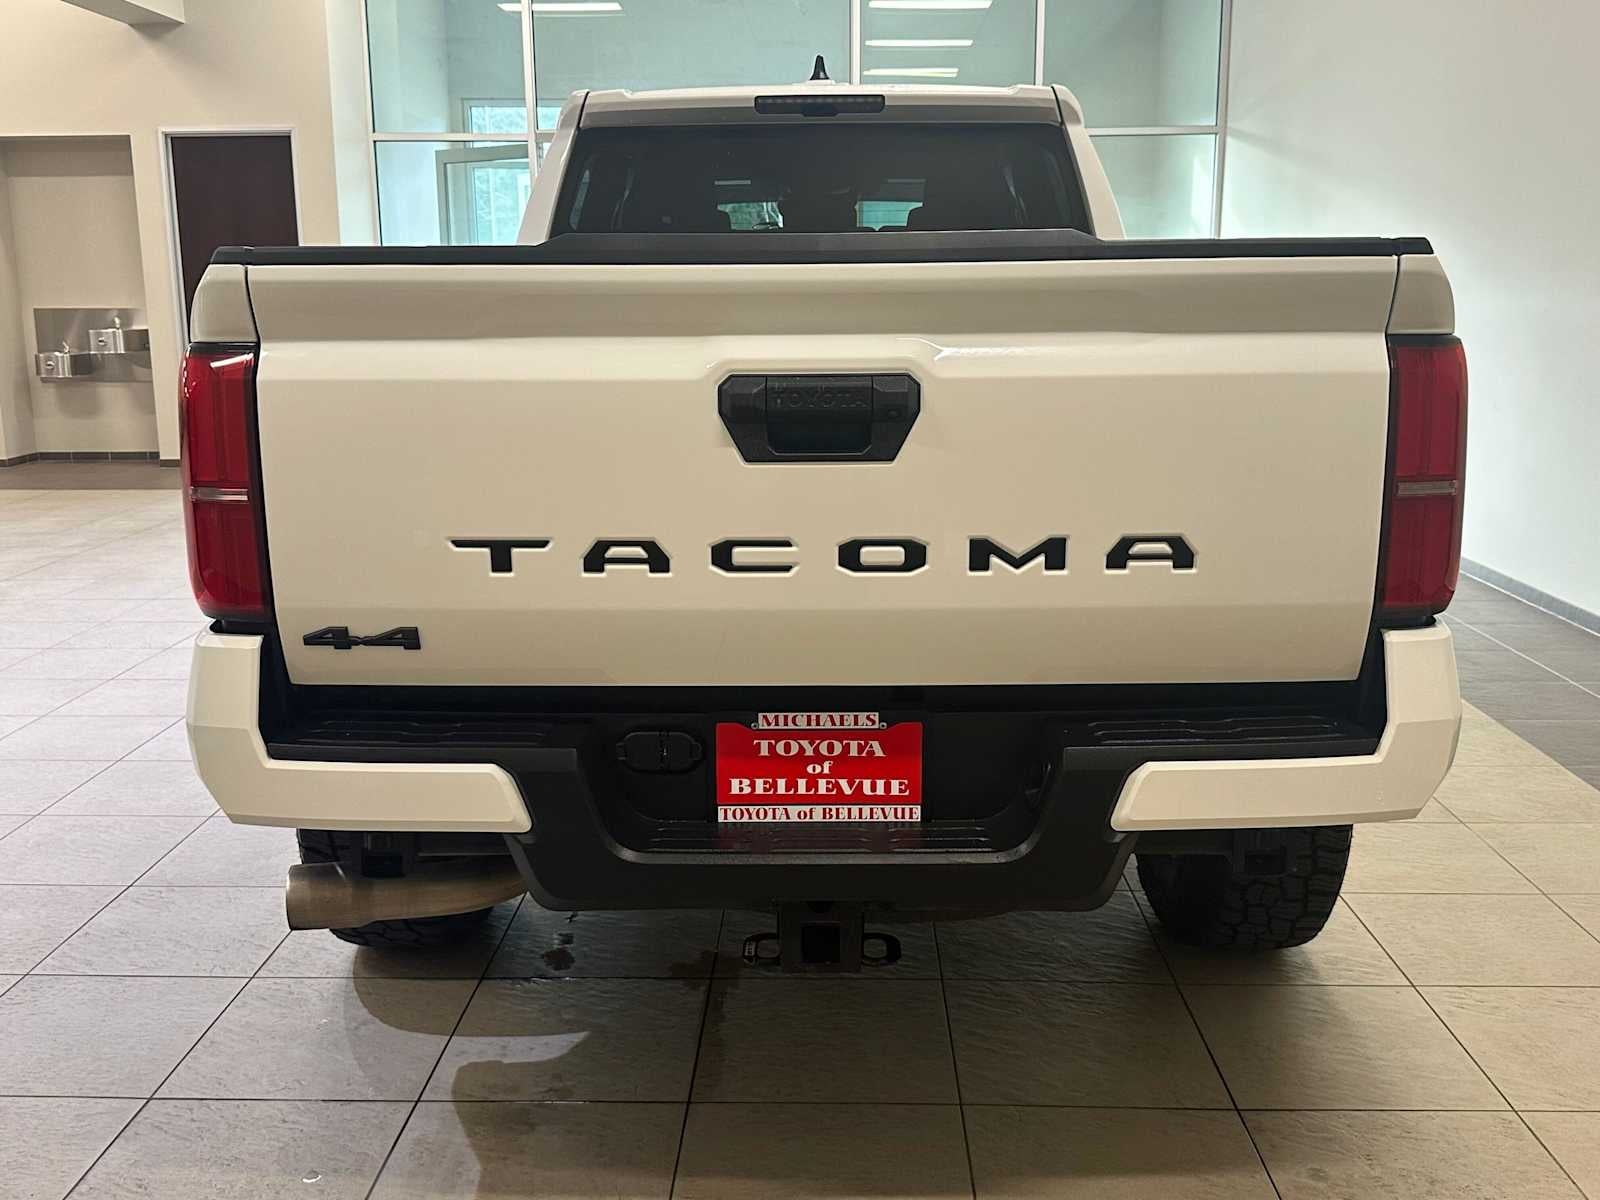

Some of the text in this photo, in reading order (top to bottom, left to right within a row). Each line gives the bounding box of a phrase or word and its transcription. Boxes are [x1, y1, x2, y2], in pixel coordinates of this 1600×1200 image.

[770, 391, 869, 408] TOYOTA
[449, 535, 1196, 573] TACOMA
[760, 714, 877, 727] MICHAELS
[754, 739, 887, 757] TOYOTA
[806, 760, 834, 774] of
[729, 778, 910, 796] BELLEVUE
[719, 807, 920, 821] TOYOTA of BELLEVUE
